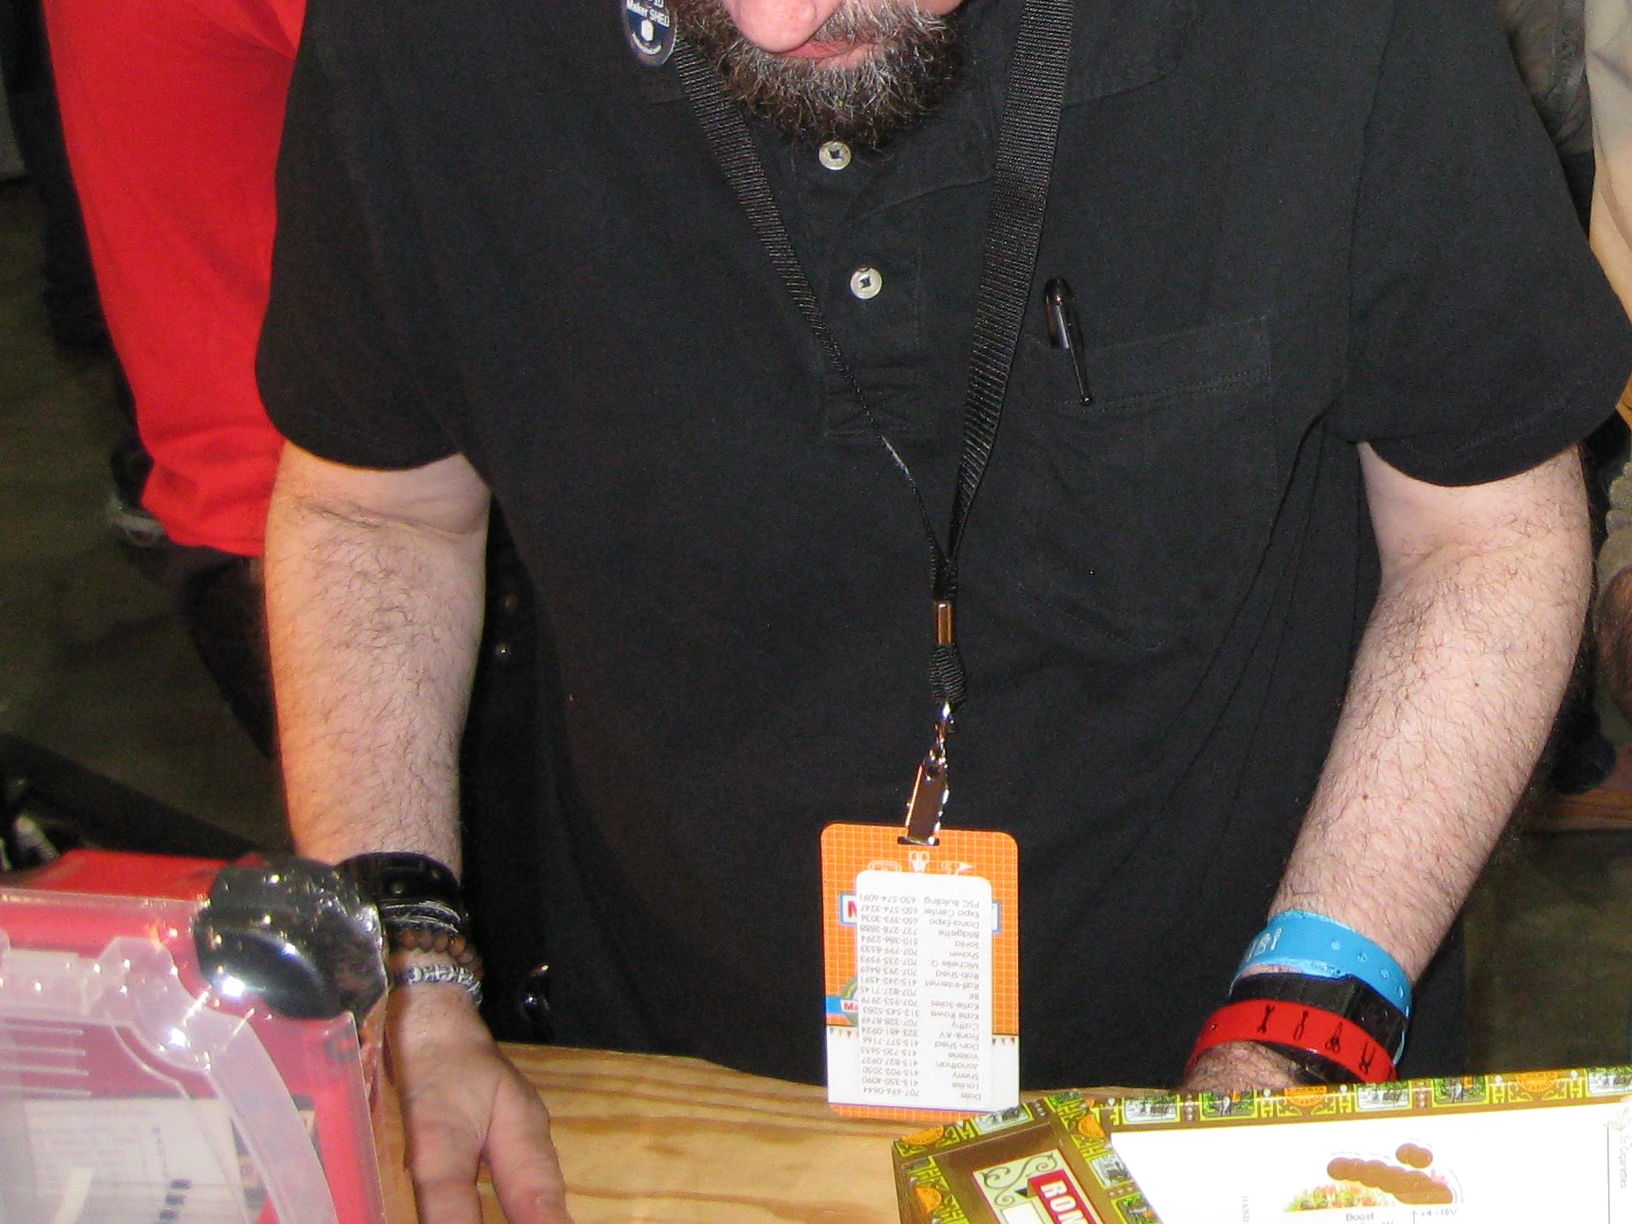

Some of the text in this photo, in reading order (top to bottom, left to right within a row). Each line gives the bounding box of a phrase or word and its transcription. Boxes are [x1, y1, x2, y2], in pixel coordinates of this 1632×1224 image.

[953, 1072, 979, 1080] Sherry
[952, 1082, 979, 1090] Louise
[1345, 1211, 1375, 1222] Boost
